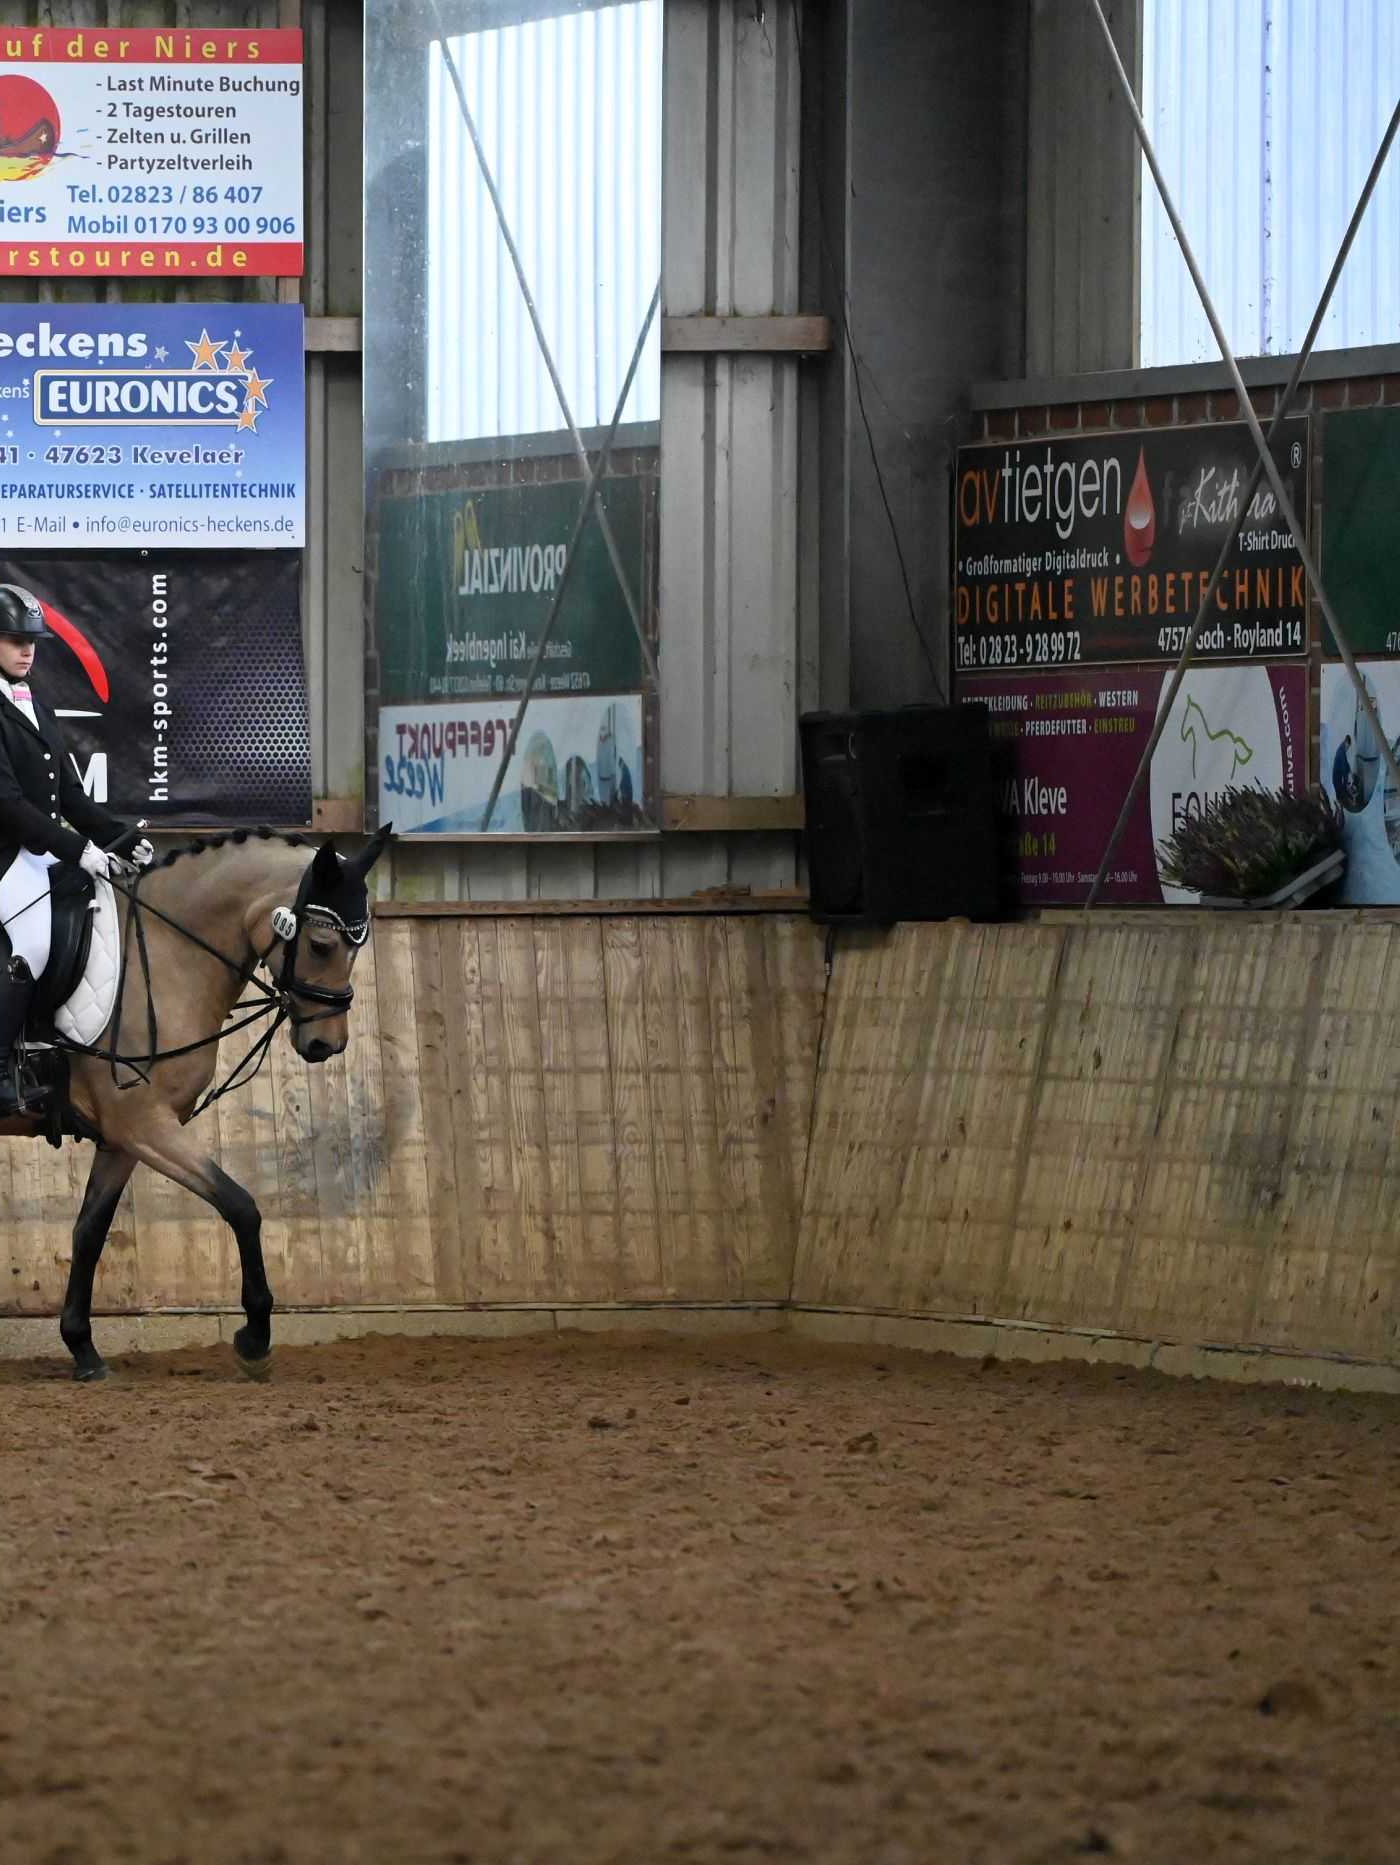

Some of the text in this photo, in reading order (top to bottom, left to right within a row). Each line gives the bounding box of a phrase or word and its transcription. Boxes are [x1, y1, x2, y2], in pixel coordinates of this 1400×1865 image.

[67, 34, 130, 59] der
[155, 34, 260, 59] Niers
[107, 75, 301, 96] Last Minute Buchung
[107, 102, 237, 122] 2 Tagestouren
[107, 129, 251, 146] Zelten u. Grillen
[107, 155, 253, 174] Partyzeltverleih
[66, 185, 263, 204] Tel. 02823 86 407
[67, 215, 296, 235] Mobil 0170 93 00 906
[48, 379, 239, 415] EURONICS
[45, 445, 123, 465] 47623
[132, 444, 246, 465] Kevelaer
[149, 483, 297, 499] SATELLITENTECHNIK
[17, 516, 66, 533] E-Mail
[86, 516, 294, 533] info@euronics-heckens.de
[1238, 531, 1269, 552] T-Shirt
[966, 546, 1109, 577] Großformatiger Digitaldruck
[957, 578, 1076, 625] DIGITALE
[1234, 621, 1283, 655] Royland
[1285, 621, 1303, 647] 14
[149, 574, 171, 801] hkm-sports.com
[1099, 690, 1139, 708] WESTERN
[1024, 776, 1067, 816] Kleve
